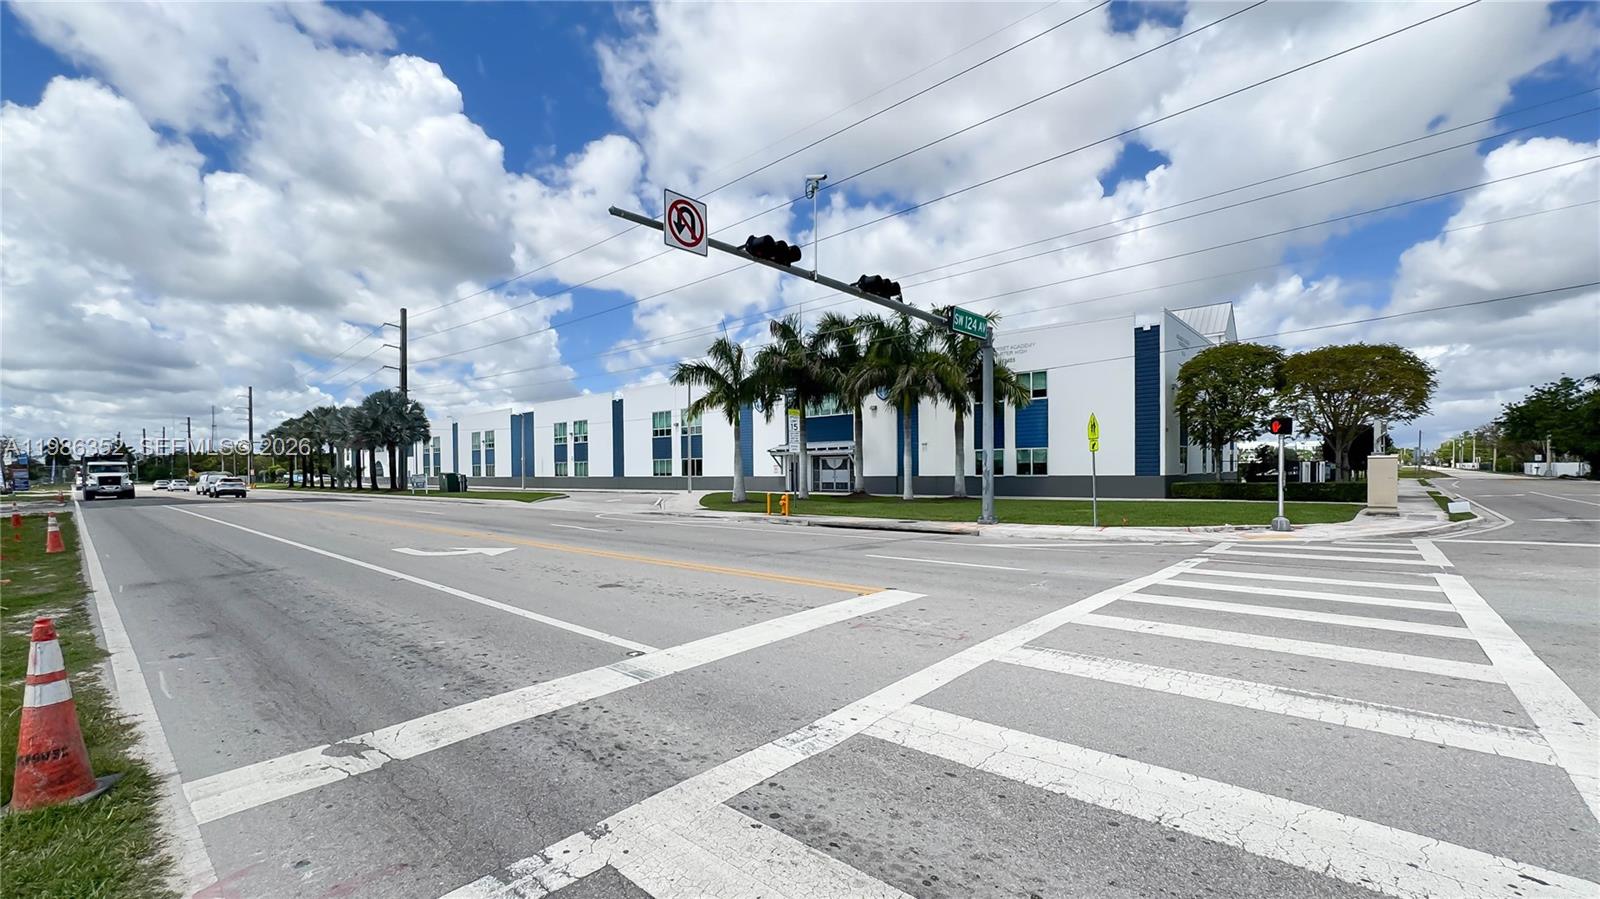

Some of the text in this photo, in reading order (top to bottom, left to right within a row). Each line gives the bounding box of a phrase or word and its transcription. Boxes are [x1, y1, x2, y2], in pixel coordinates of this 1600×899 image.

[954, 313, 987, 333] SW 124 AV
[790, 423, 798, 431] 15
